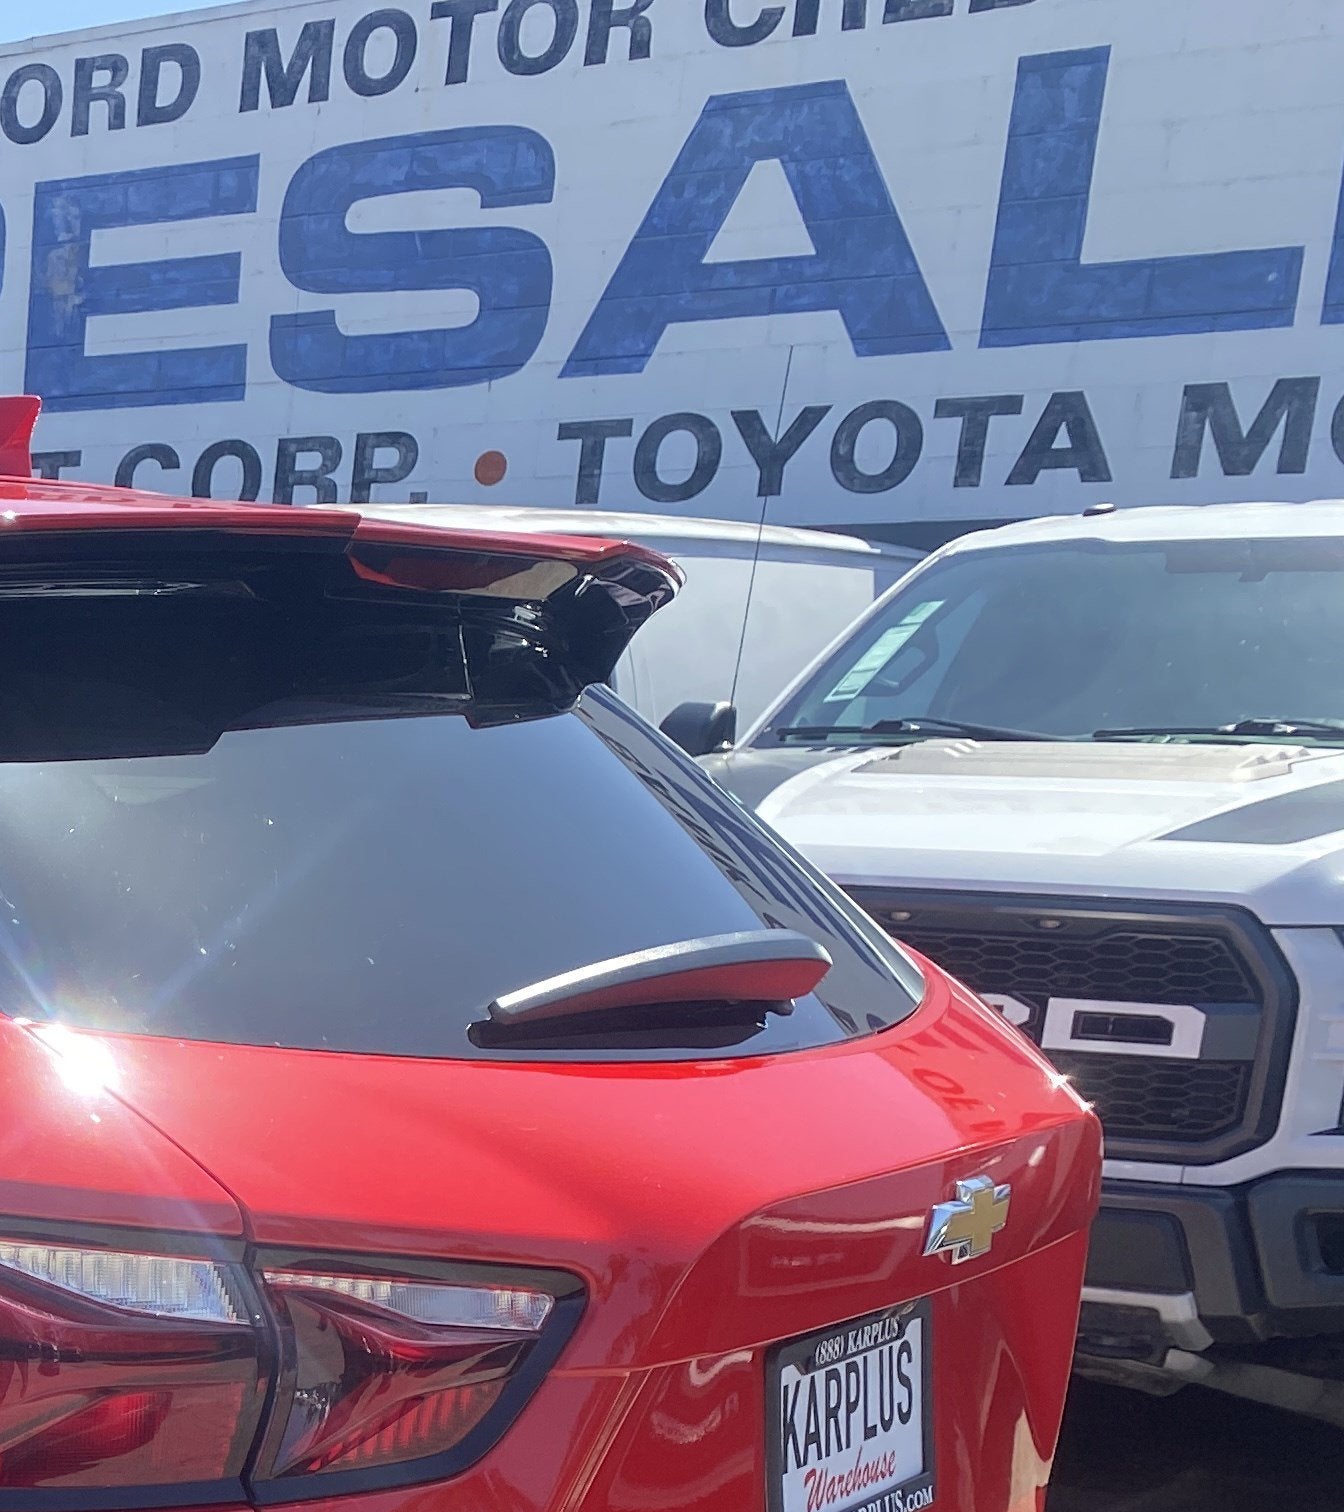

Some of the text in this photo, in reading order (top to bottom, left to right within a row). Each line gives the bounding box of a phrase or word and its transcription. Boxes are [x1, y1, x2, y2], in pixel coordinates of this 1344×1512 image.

[240, 0, 651, 113] MOTOR
[557, 391, 1112, 505] TOYOTA
[1170, 376, 1344, 480] M
[814, 1316, 901, 1367] (888) KARPLUS
[782, 1340, 913, 1475] KARPLUS
